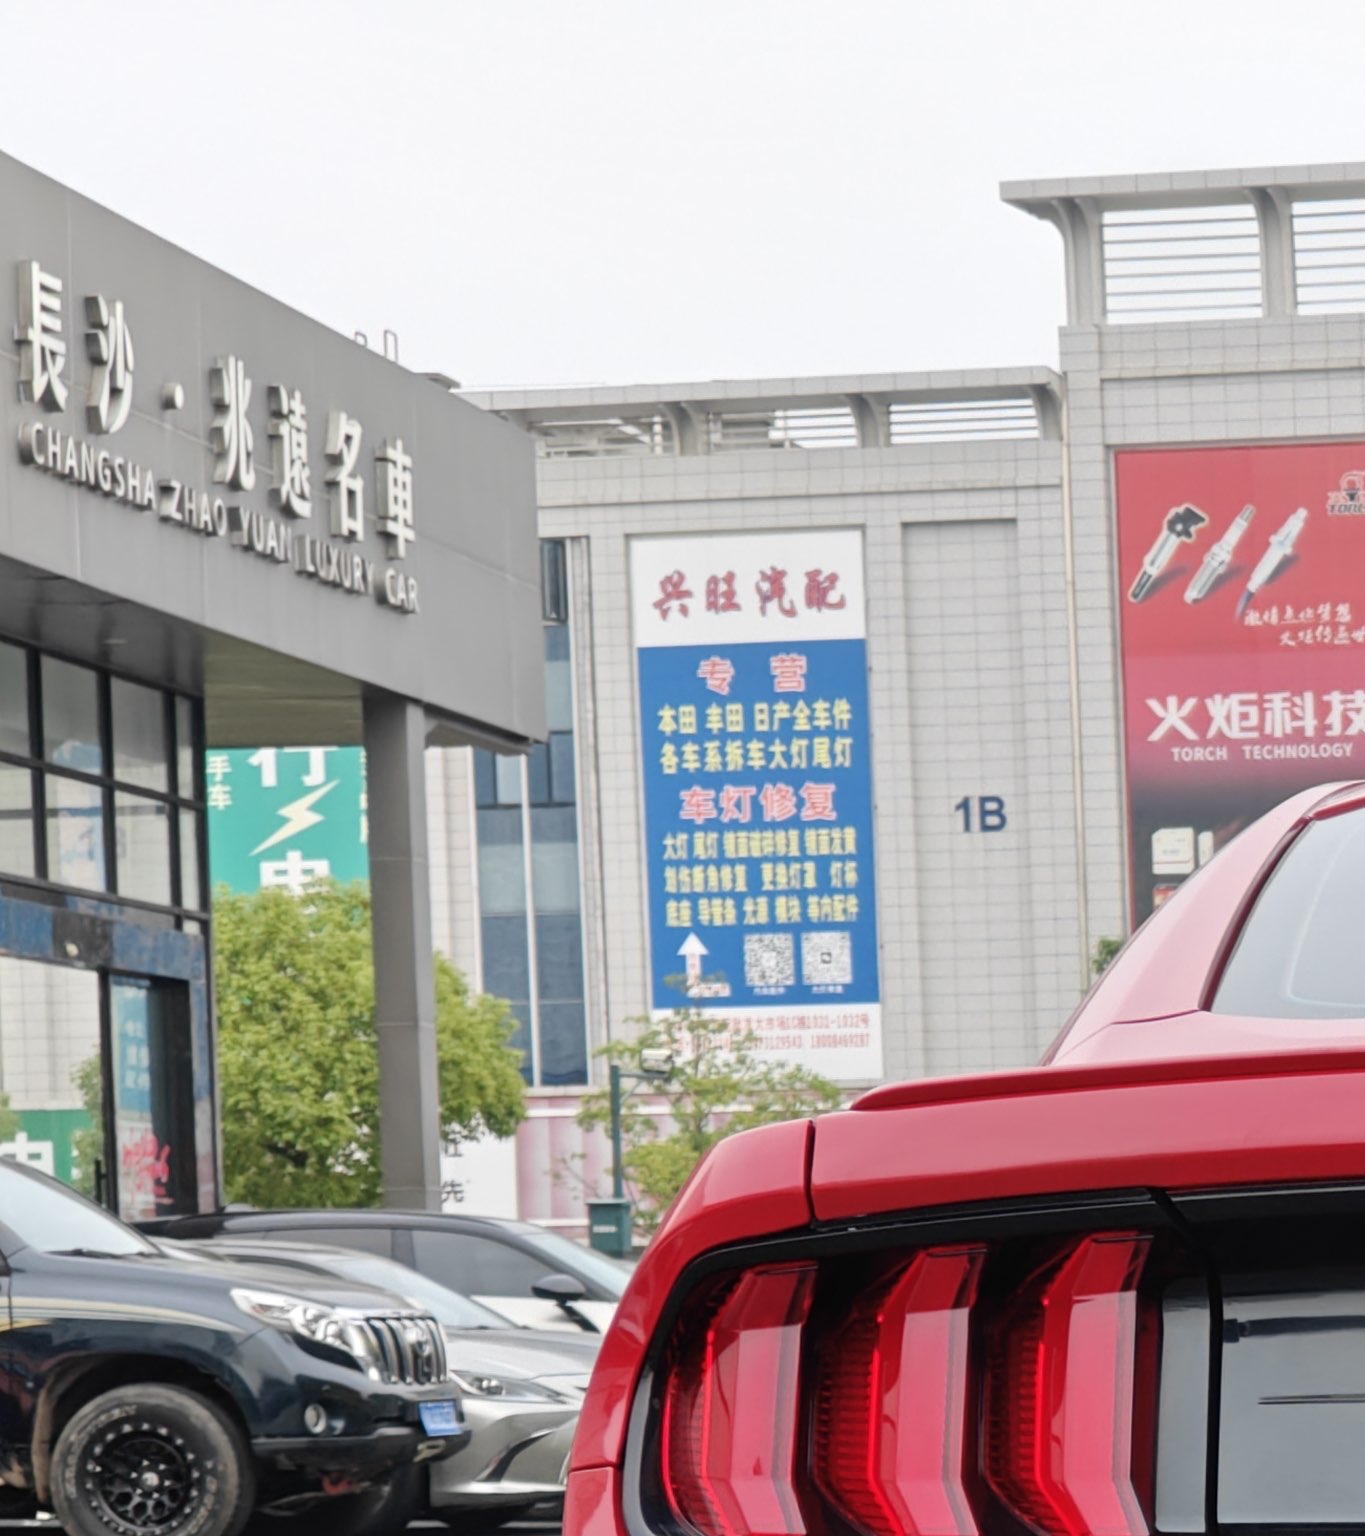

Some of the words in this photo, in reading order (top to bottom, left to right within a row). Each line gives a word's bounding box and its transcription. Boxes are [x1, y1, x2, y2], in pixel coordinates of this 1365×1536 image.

[29, 421, 157, 510] CHANGSHA
[169, 479, 228, 537] ZHAO
[238, 506, 292, 562] YUAN
[304, 533, 376, 597] LUXURY
[384, 567, 421, 614] CAR
[652, 566, 846, 619] 兴旺汽配
[696, 653, 808, 695] 专营
[705, 702, 744, 735] 丰田
[1171, 746, 1228, 762] TORCH
[1242, 742, 1354, 761] TECHNOLOGY
[679, 780, 838, 825] 车灯修复
[955, 796, 1008, 833] 1B
